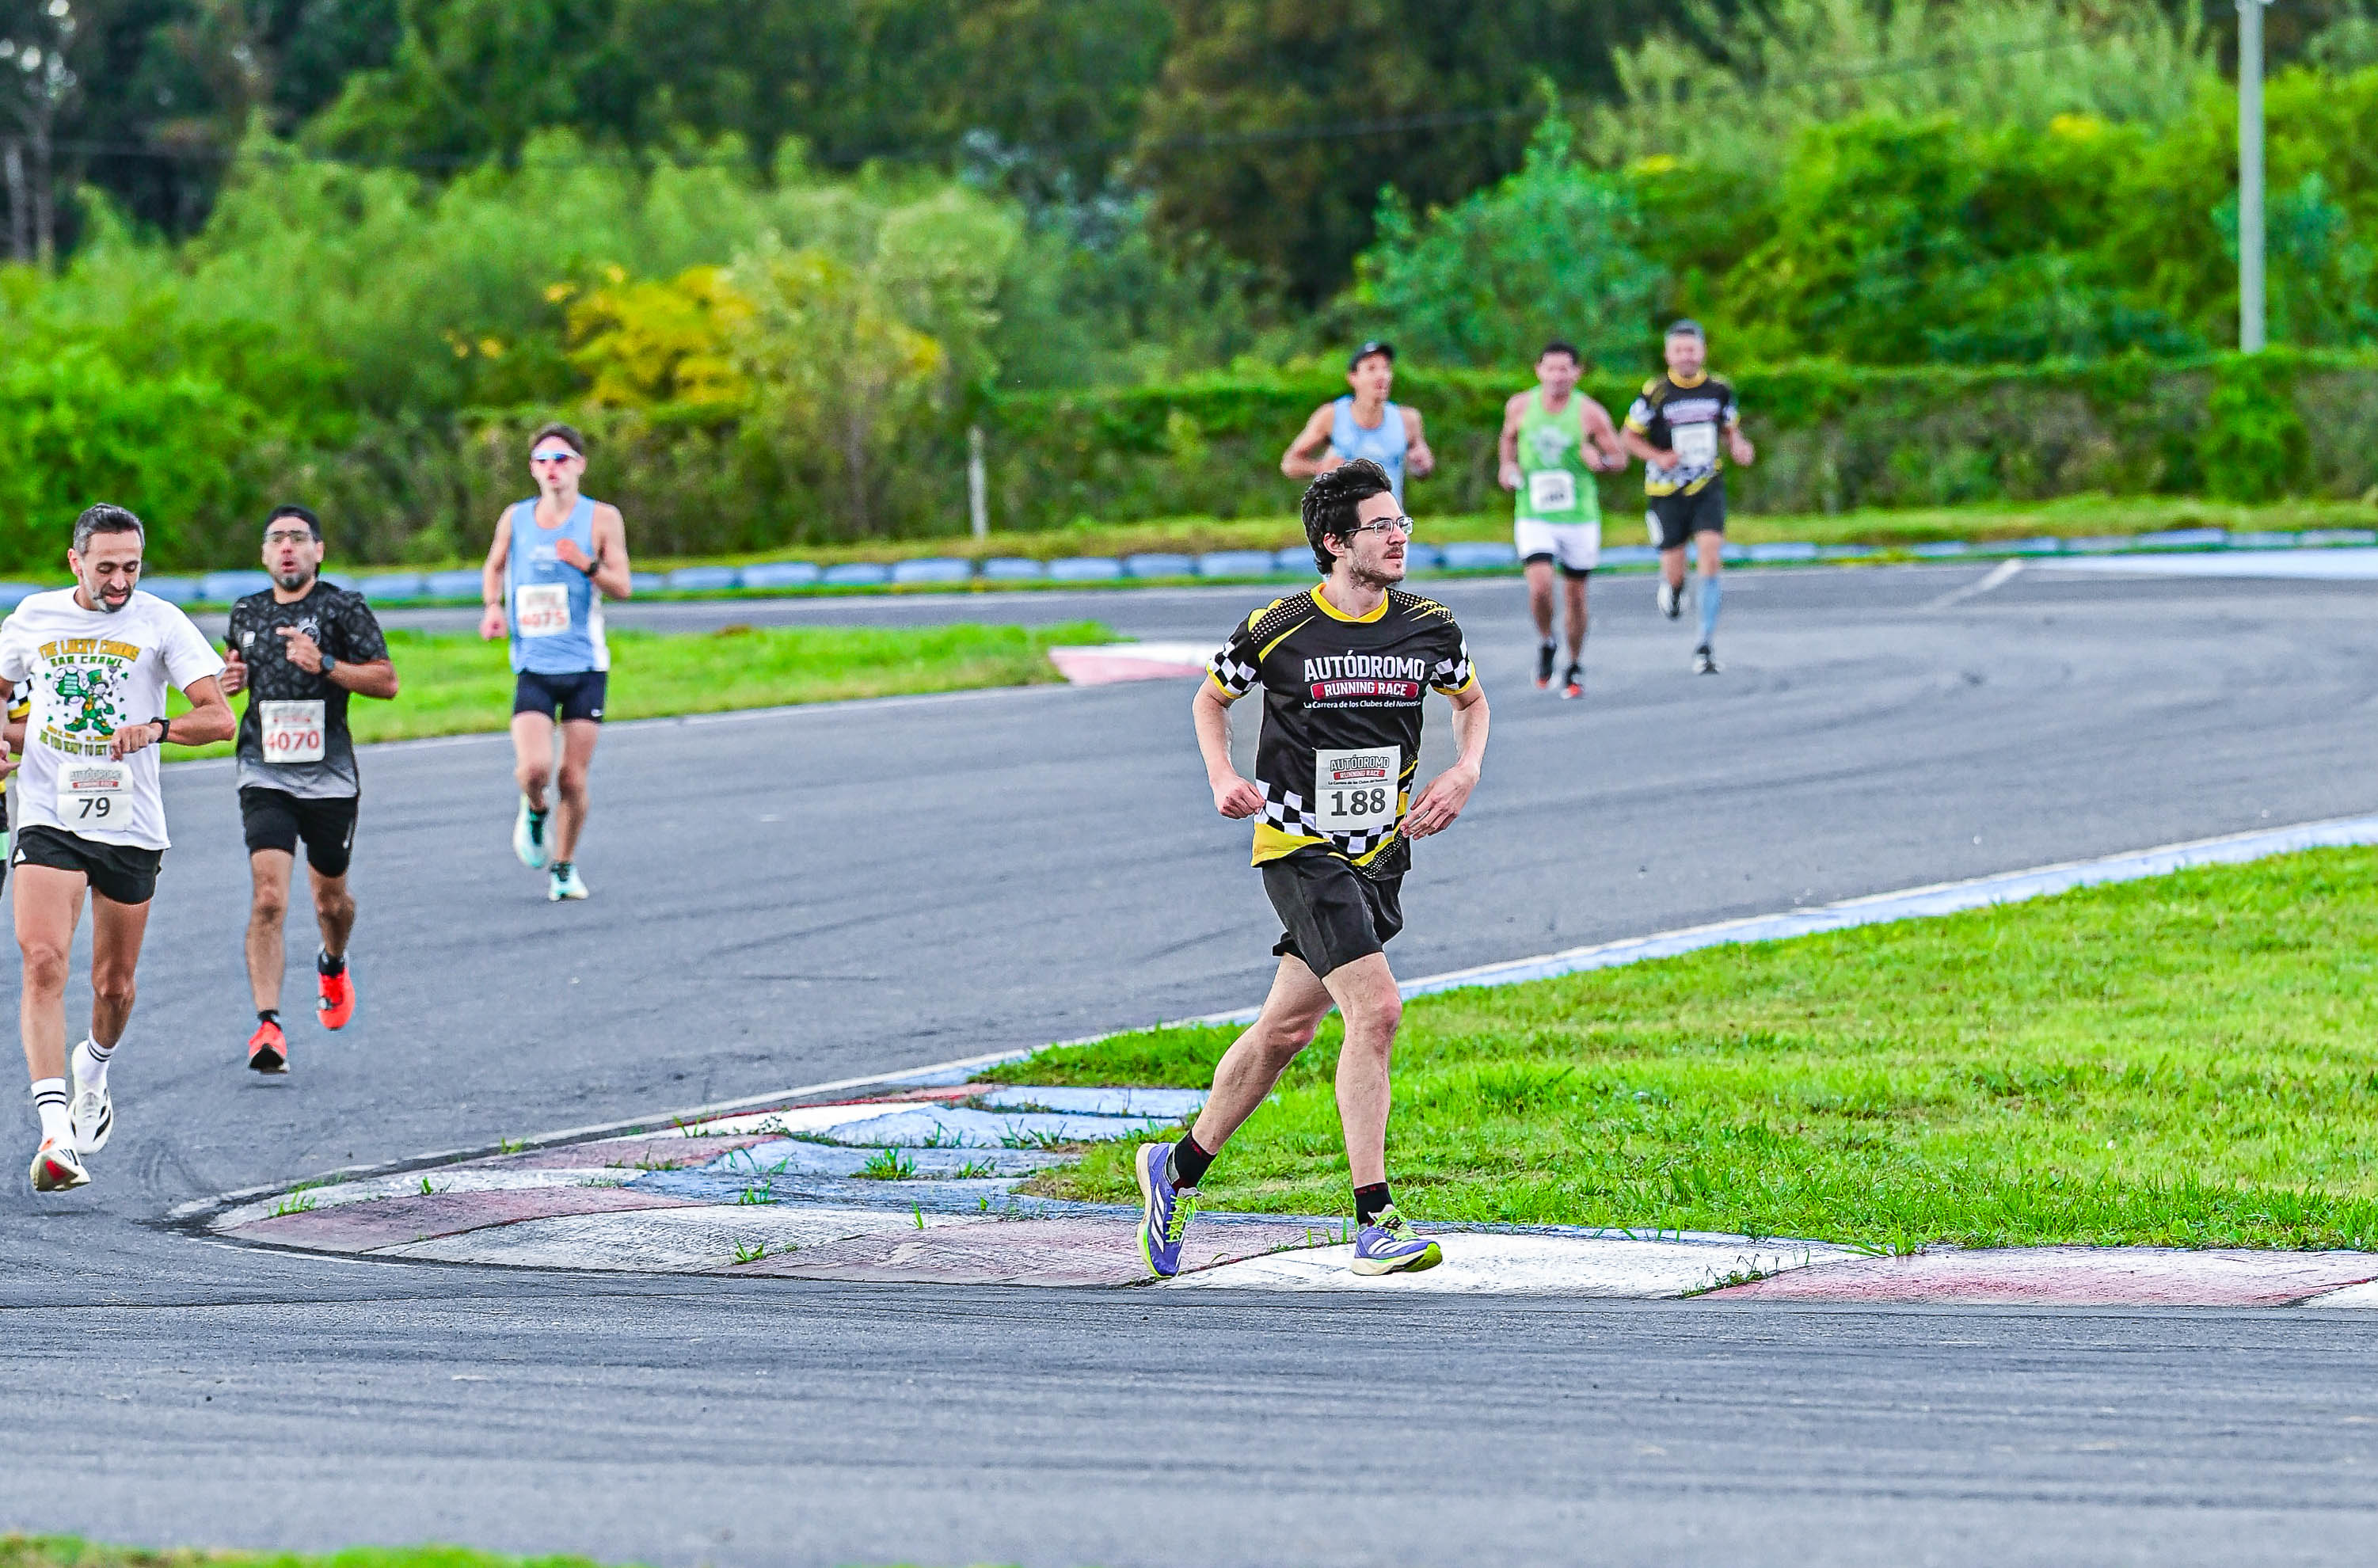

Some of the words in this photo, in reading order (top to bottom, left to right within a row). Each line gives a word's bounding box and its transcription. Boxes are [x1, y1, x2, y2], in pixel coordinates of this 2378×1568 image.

[1303, 649, 1425, 682] AUTÓDROMO
[1324, 682, 1375, 696] RUNNING
[1378, 682, 1408, 696] RACE
[266, 730, 320, 751] 4070
[1330, 754, 1390, 771] AUTÓDROMO
[78, 797, 110, 819] 79
[1331, 788, 1386, 816] 188
